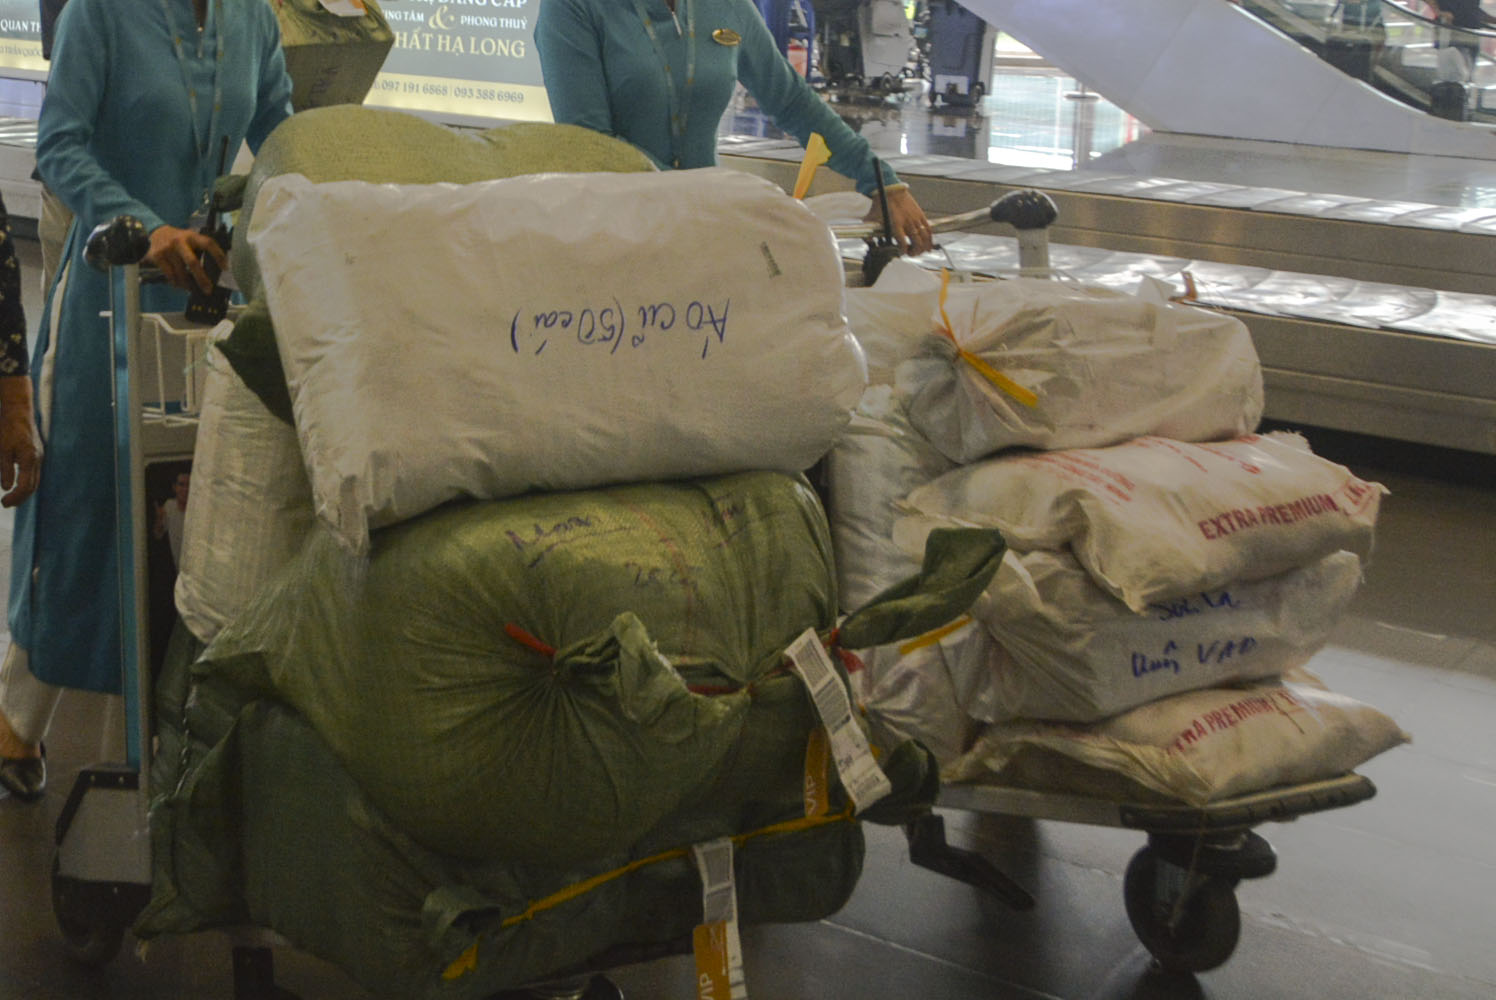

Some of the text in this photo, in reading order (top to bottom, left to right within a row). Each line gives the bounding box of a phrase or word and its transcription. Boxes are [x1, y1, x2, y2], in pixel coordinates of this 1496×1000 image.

[0, 18, 28, 32] QUAN
[429, 5, 454, 30] &
[460, 14, 498, 29] PHONG
[394, 26, 526, 59] HẤT HẠ LONG
[382, 80, 400, 92] 097
[403, 82, 420, 94] 191
[454, 87, 474, 99] 093
[497, 91, 524, 103] 6969
[1198, 508, 1258, 540] EXTRA
[1257, 494, 1340, 526] PREMIUM
[1202, 697, 1274, 732] PREMIUM
[806, 775, 818, 816] VIP
